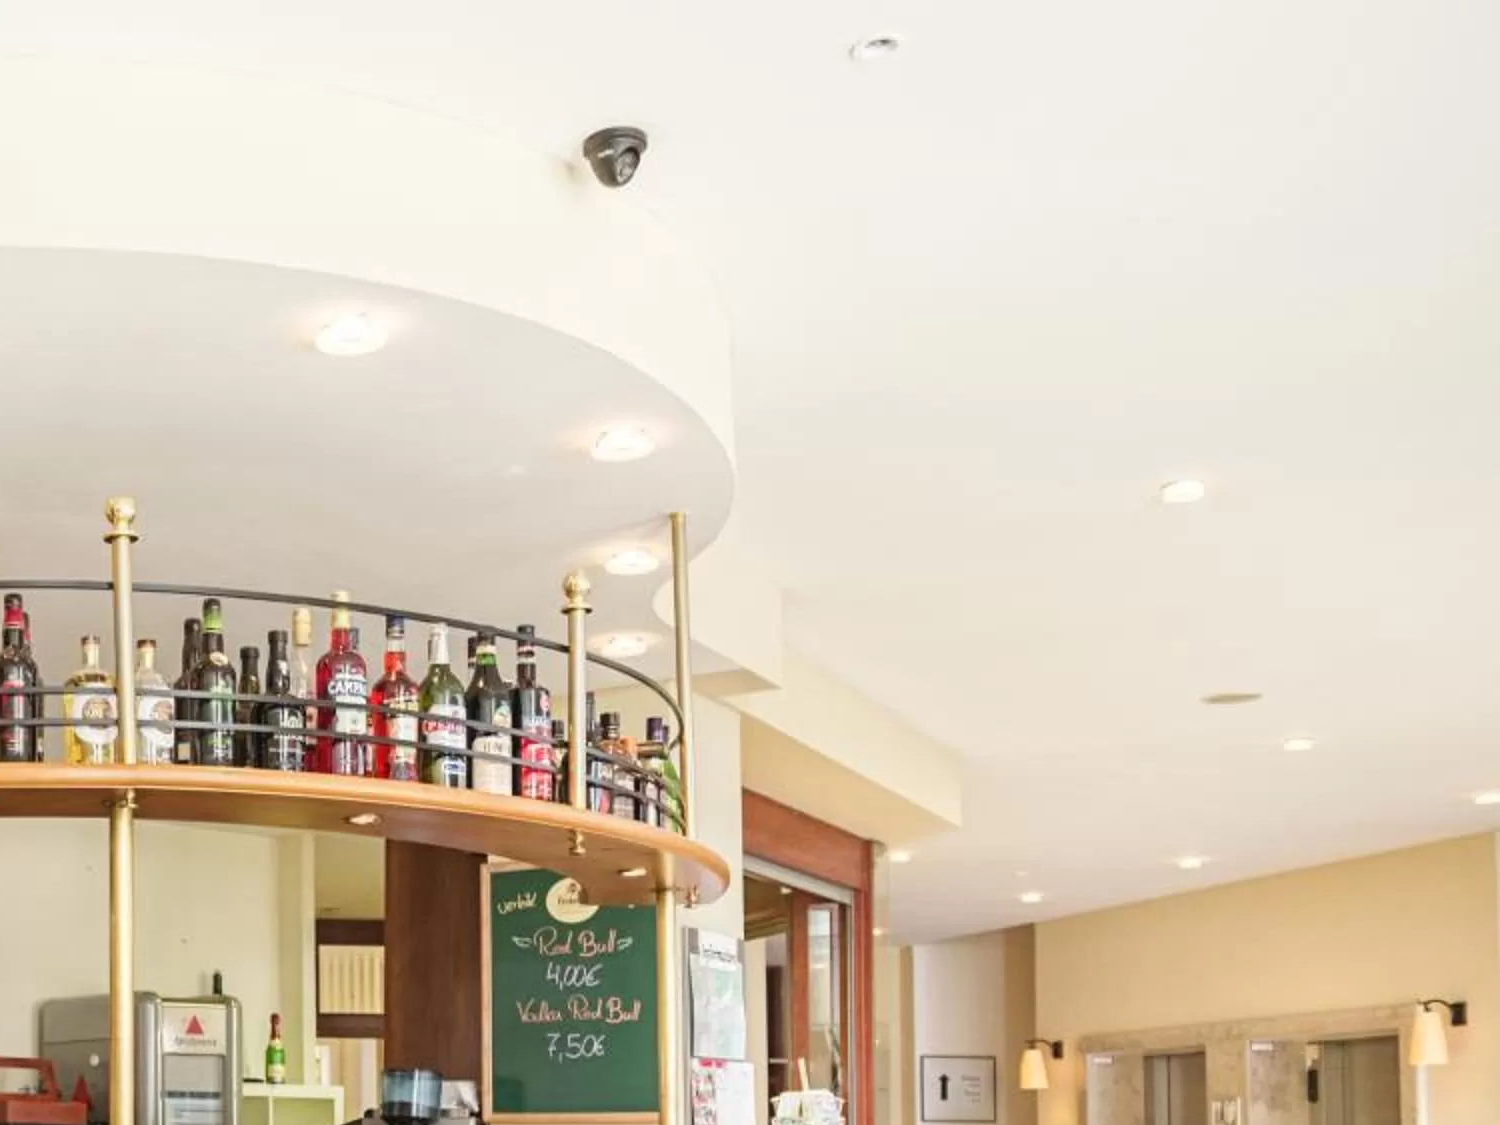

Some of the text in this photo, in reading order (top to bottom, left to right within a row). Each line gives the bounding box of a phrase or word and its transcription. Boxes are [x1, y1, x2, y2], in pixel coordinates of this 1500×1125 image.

[533, 926, 618, 957] Red Bull
[545, 961, 604, 991] 4,00€
[567, 994, 603, 1021] Red
[605, 996, 642, 1023] Bull
[546, 1032, 606, 1064] 7,50€
